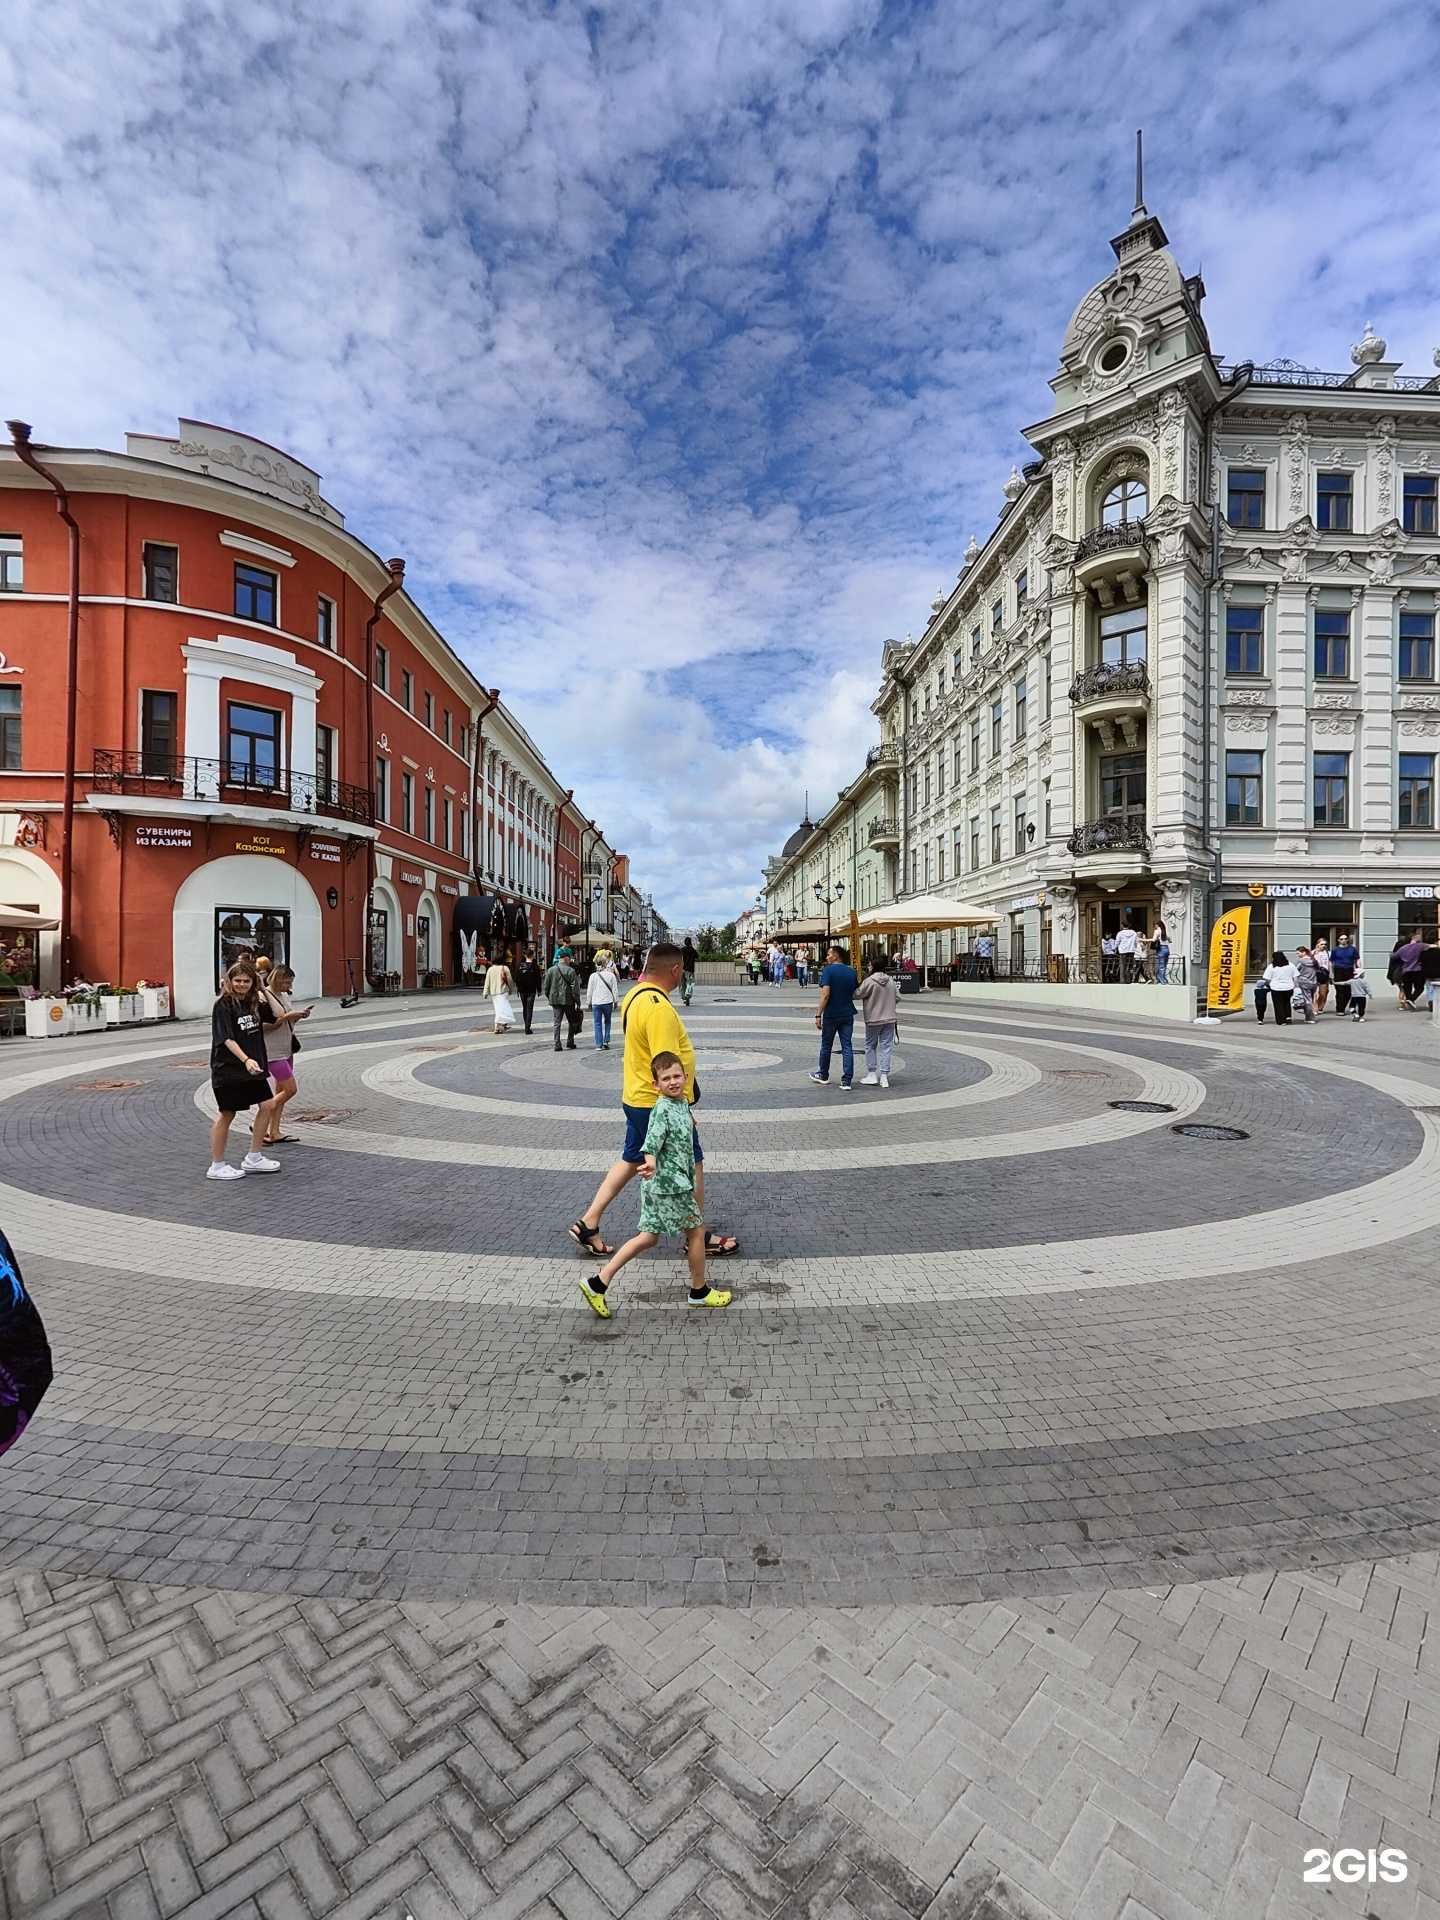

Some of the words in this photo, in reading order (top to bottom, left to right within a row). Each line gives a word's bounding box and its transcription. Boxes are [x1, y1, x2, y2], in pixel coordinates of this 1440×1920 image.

[136, 827, 192, 837] СУВЕНИРЫ
[136, 837, 150, 846] ИЗ
[151, 838, 192, 847] КАЗАНИ
[252, 836, 270, 845] КОТ
[235, 842, 286, 854] Казанский
[1218, 939, 1234, 1006] КЫСТЫБЫЙ
